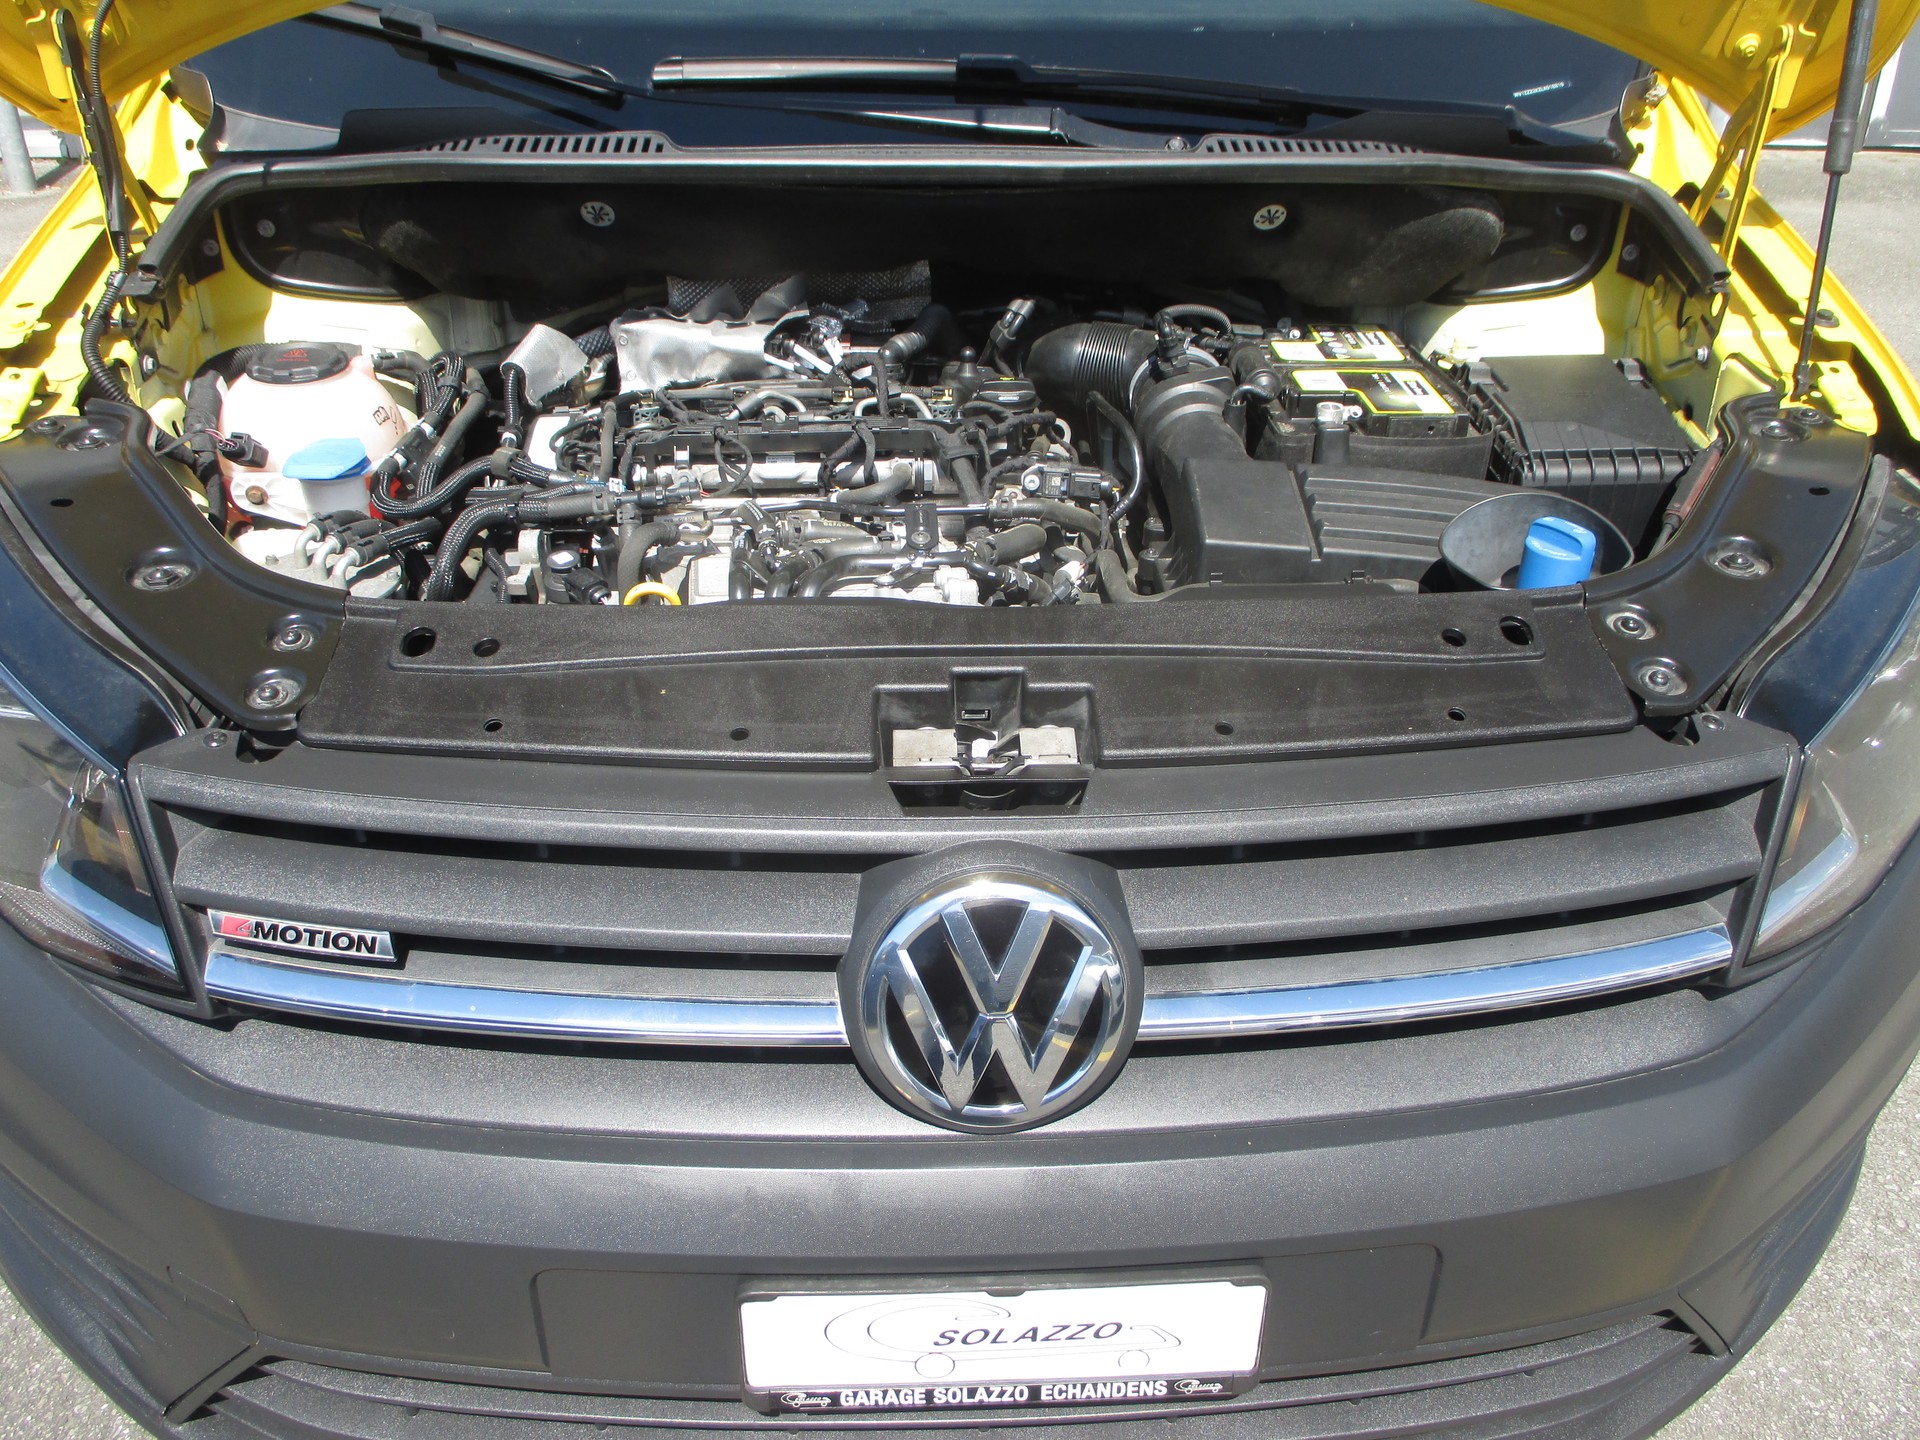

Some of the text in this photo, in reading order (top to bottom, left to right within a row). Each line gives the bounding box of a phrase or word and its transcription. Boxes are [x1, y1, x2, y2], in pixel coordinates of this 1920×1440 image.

[237, 921, 378, 954] 4MOTION
[932, 1321, 1123, 1347] SOLAZZO
[839, 1379, 1168, 1408] GARAGE SOLAZZO ECHANDENS
